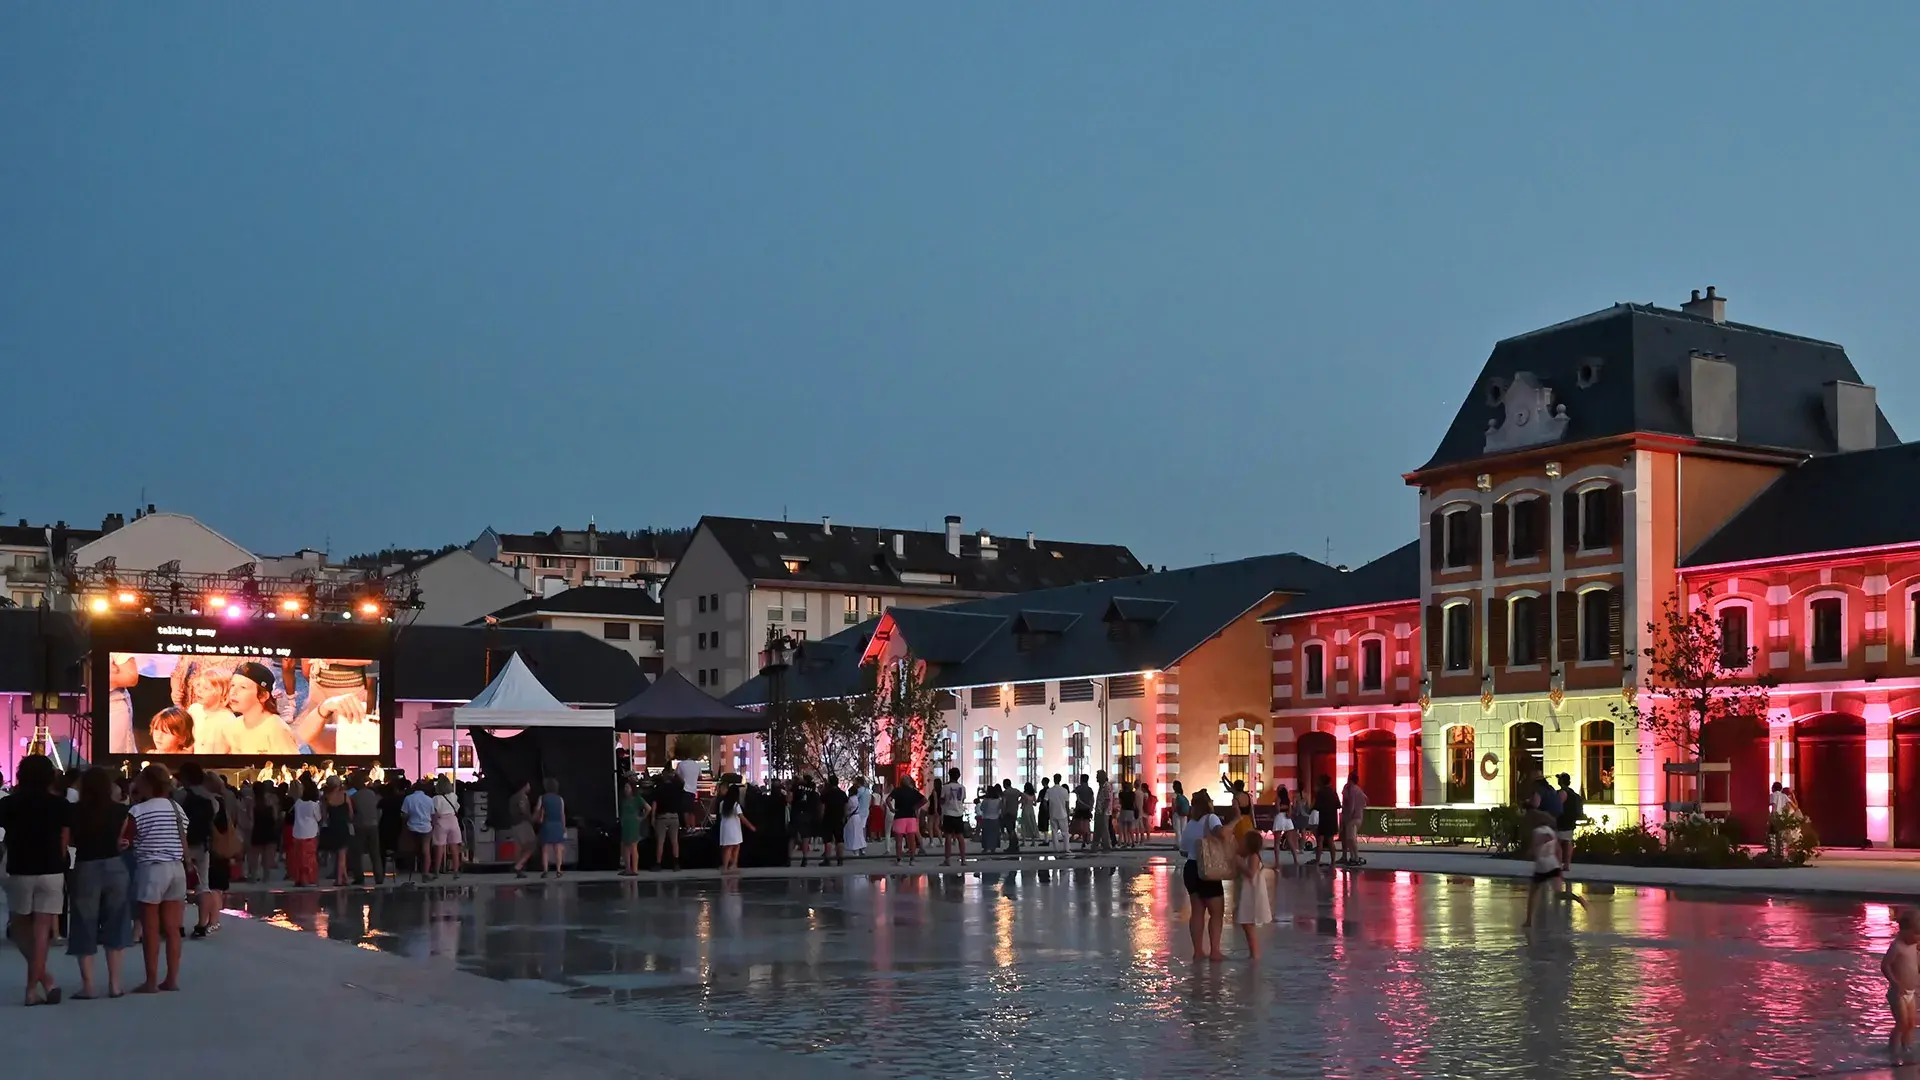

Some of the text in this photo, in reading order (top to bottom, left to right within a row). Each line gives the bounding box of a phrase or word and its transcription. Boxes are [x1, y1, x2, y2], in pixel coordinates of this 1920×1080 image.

[157, 626, 216, 637] talking away
[157, 643, 291, 656] I don't know what I'm to say
